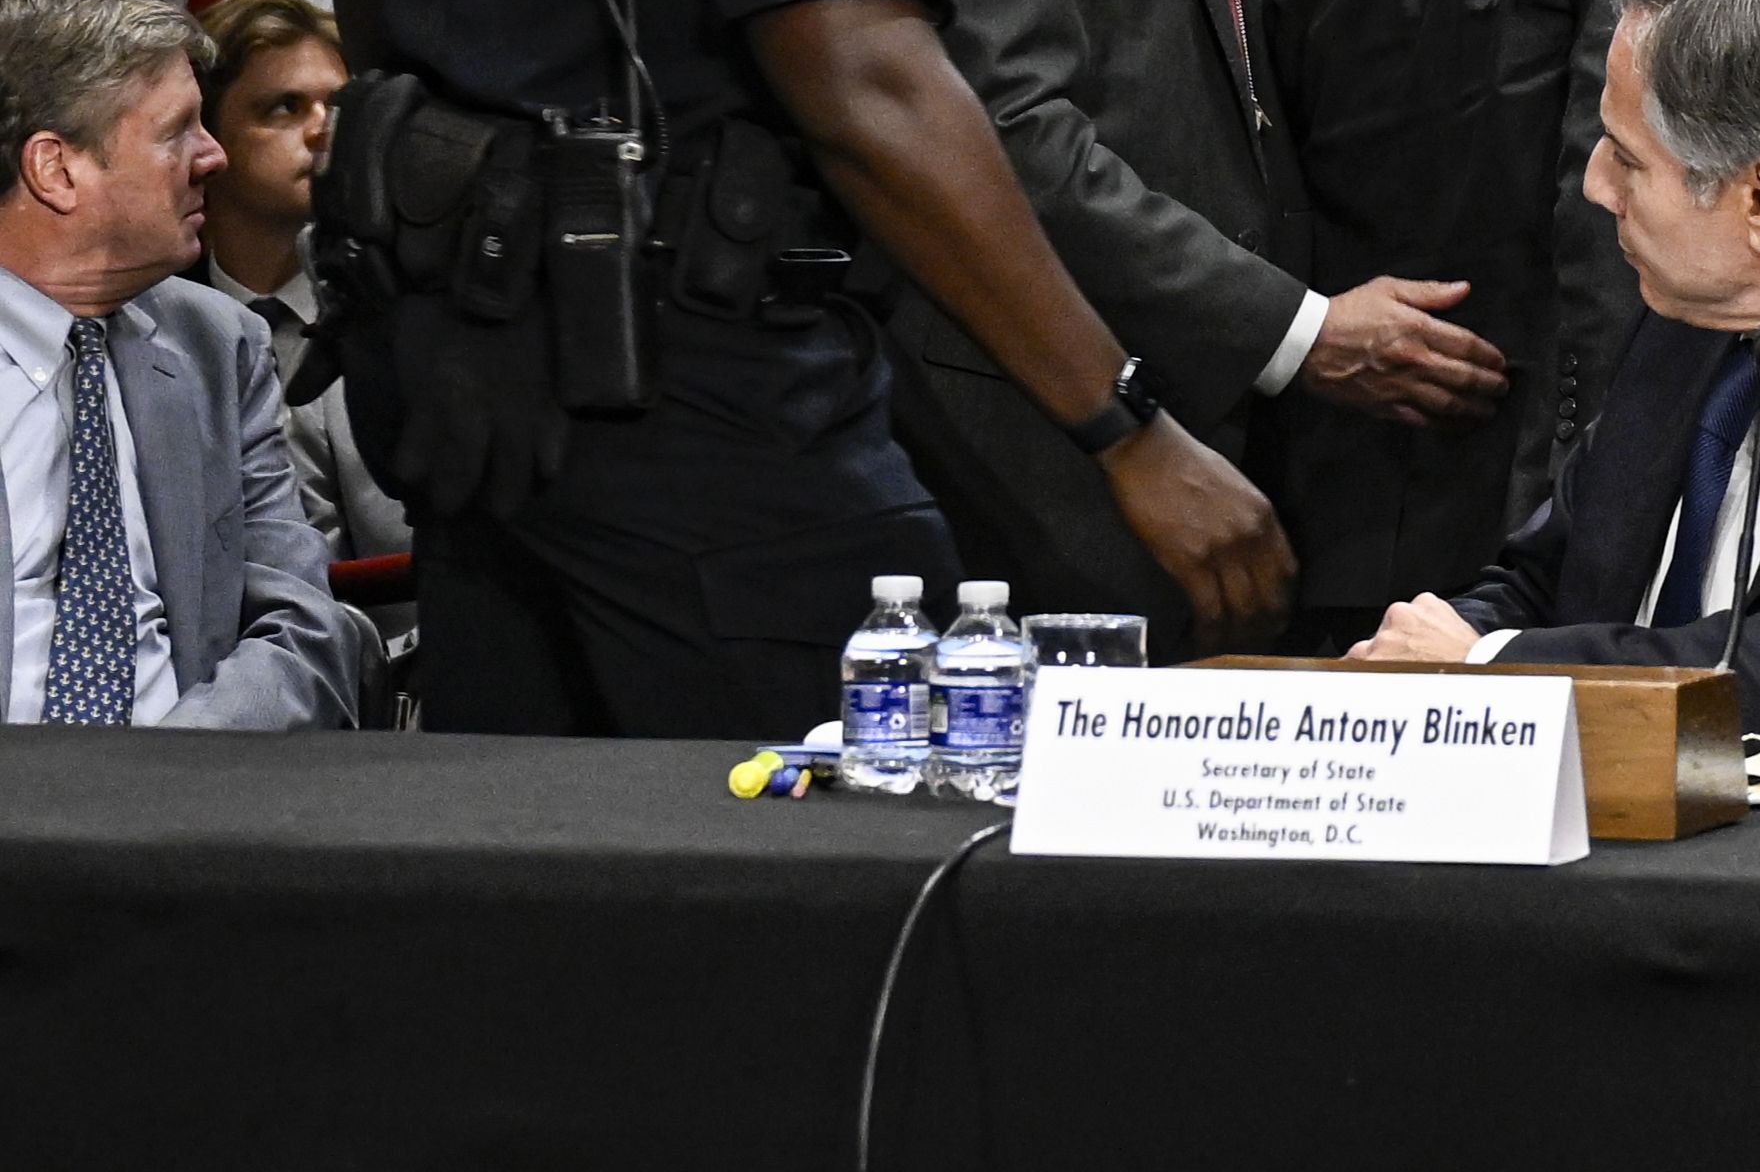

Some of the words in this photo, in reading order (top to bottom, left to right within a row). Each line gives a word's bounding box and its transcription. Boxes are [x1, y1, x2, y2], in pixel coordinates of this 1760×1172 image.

[1057, 698, 1107, 738] The
[1121, 701, 1281, 742] Honorable
[1294, 705, 1408, 756] Antony
[1422, 705, 1537, 746] Blinken
[1202, 758, 1291, 784] Secretary
[1299, 760, 1318, 780] of
[1326, 760, 1376, 781] State
[1162, 789, 1200, 809] U.S.
[1209, 789, 1321, 815] Department
[1329, 792, 1348, 812] of
[1357, 792, 1407, 813] State
[1198, 822, 1315, 848] Washington,
[1325, 824, 1363, 845] D.C.
